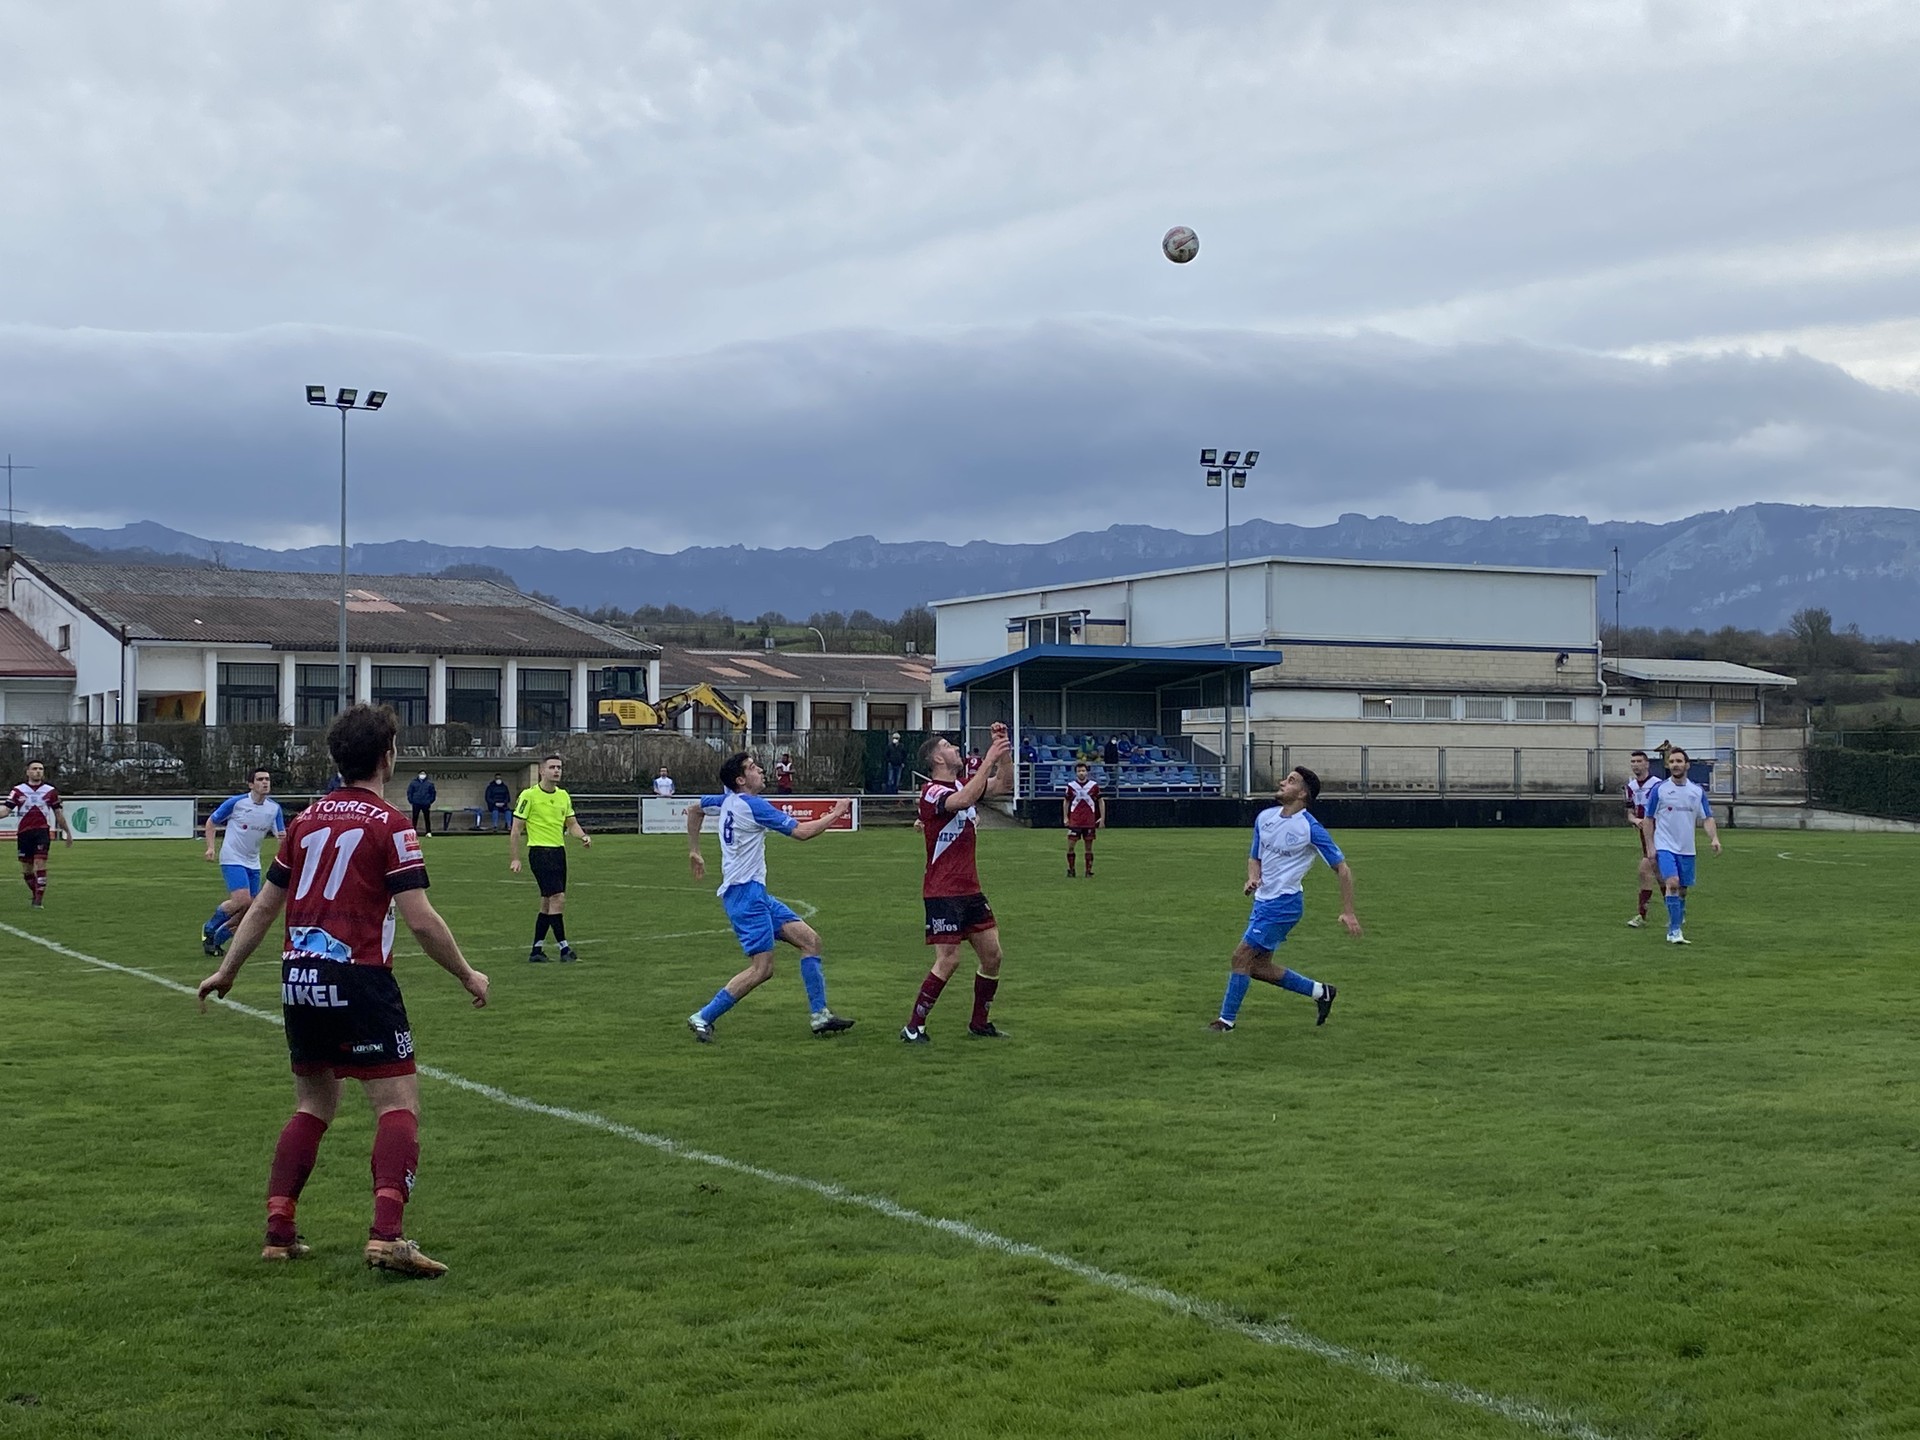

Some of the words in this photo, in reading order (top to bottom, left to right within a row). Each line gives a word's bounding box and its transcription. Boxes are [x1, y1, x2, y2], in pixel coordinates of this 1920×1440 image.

[970, 758, 978, 767] 9
[315, 800, 390, 824] TORRETA
[294, 826, 365, 901] 11
[287, 967, 319, 983] BAR
